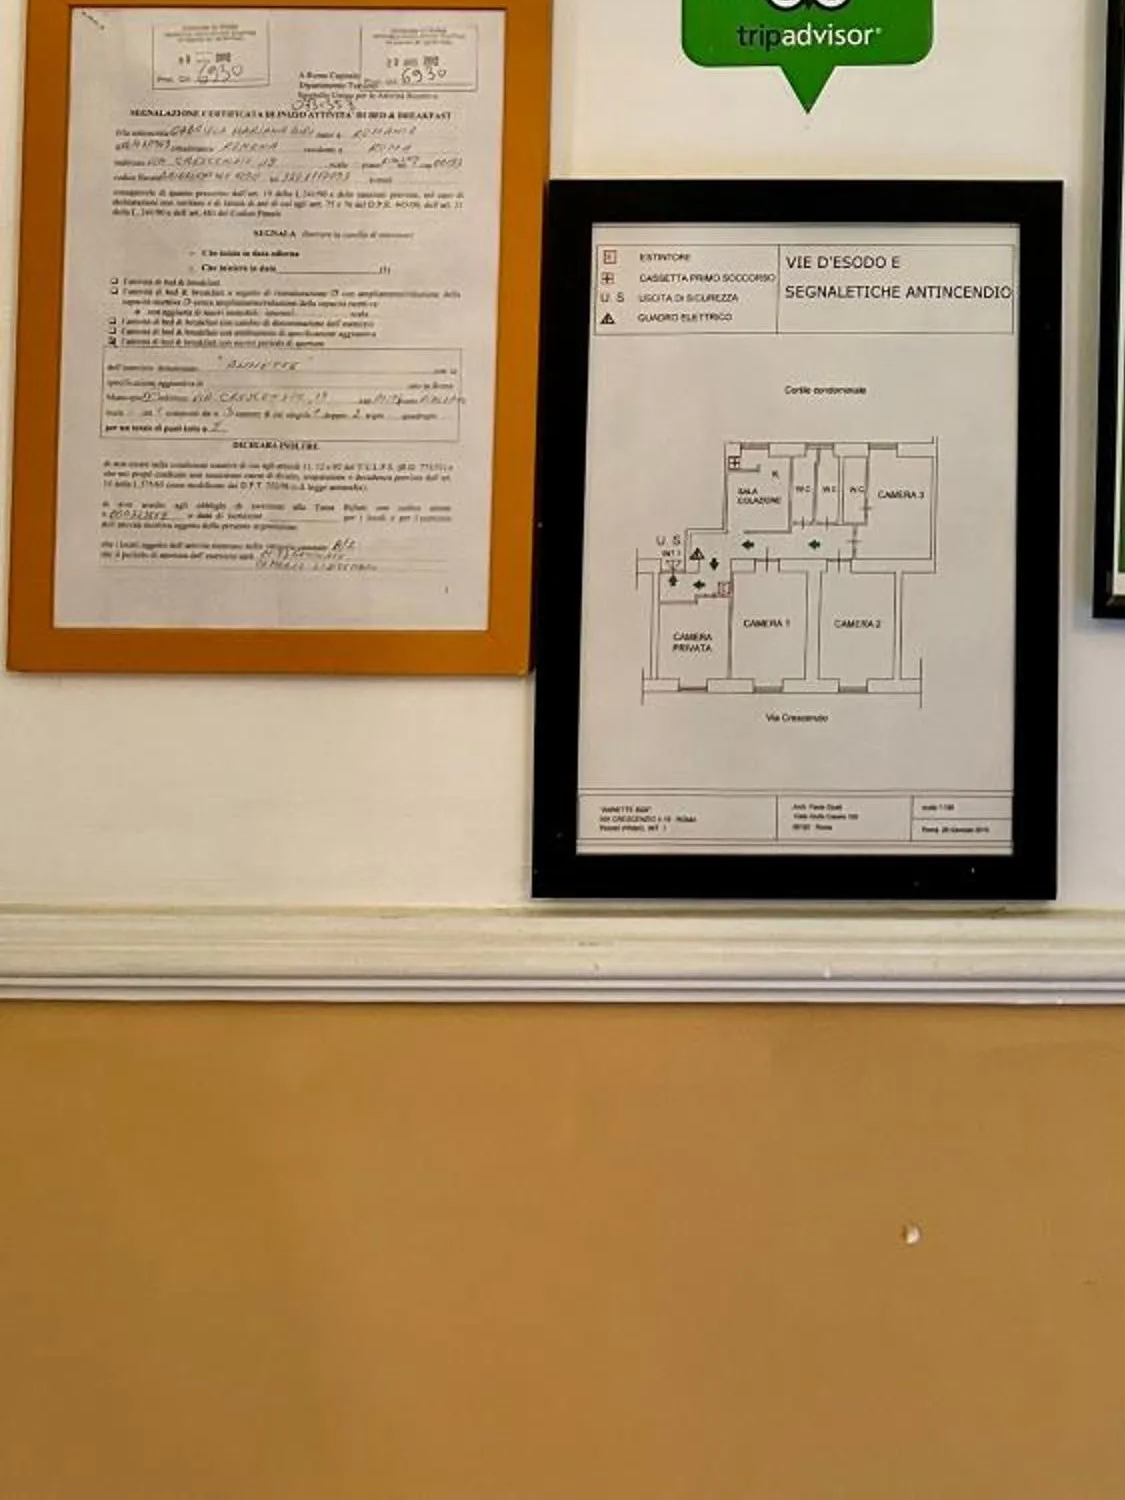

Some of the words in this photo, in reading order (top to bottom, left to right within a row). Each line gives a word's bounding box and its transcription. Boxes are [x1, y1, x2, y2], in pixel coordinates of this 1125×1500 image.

[737, 23, 873, 51] tripadvisor
[640, 253, 690, 261] ESTINTORE
[786, 256, 811, 269] VIE
[818, 256, 887, 269] D'ESODO
[892, 257, 900, 269] E
[640, 274, 689, 282] CASSETTA
[690, 274, 720, 282] PRIMO
[722, 273, 776, 282] SOCCORSO
[785, 286, 900, 299] SEGNALETICHE
[906, 286, 1012, 299] ANTINCENDIO
[639, 294, 673, 302] USCITA
[638, 314, 678, 322] QUADRO
[877, 491, 914, 499] CAMERA
[743, 619, 782, 628] CAMERA
[834, 619, 872, 628] CAMERA
[673, 633, 712, 642] CAMERA
